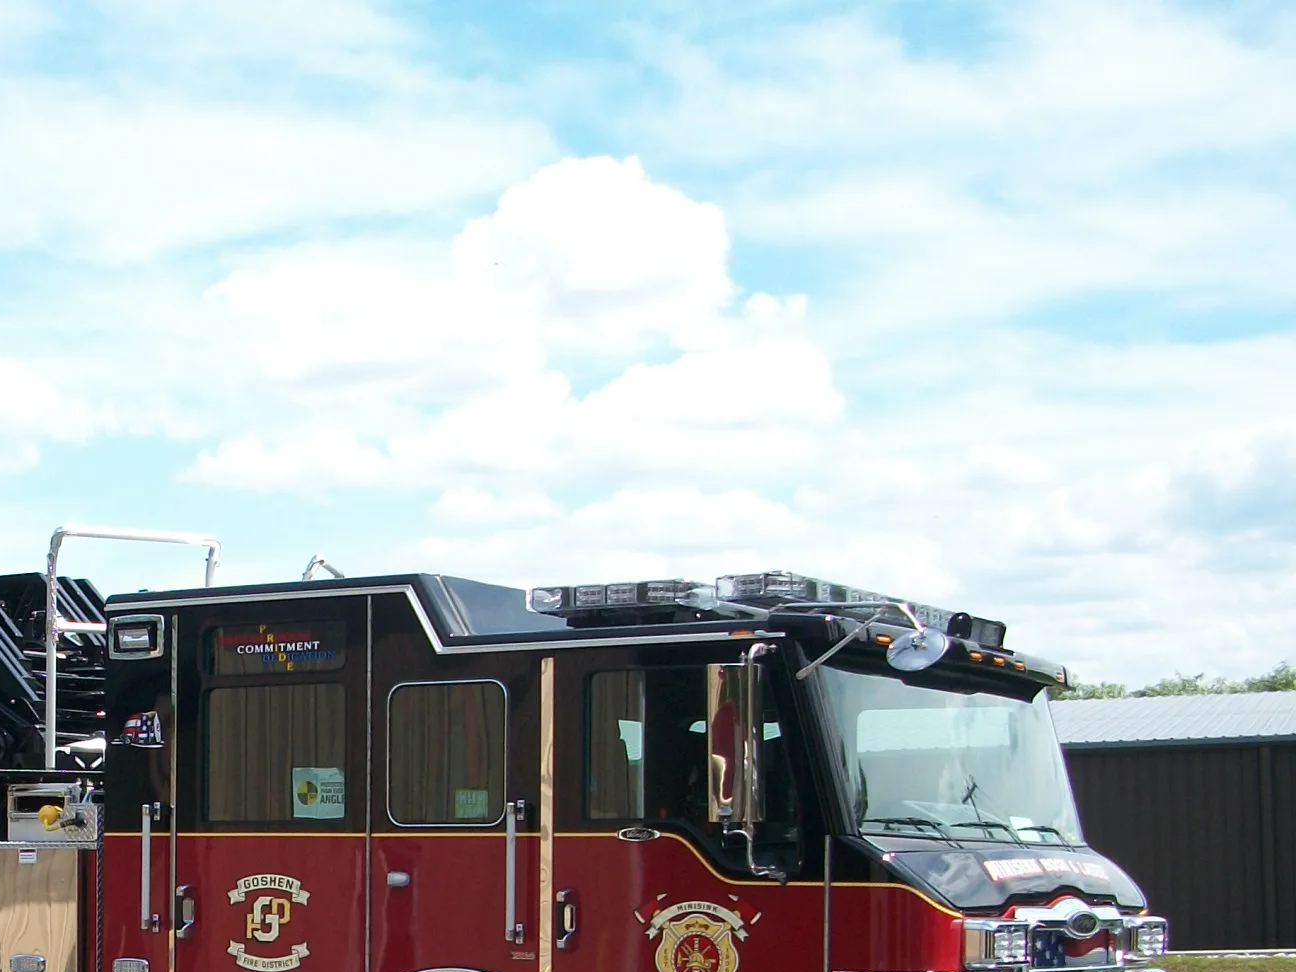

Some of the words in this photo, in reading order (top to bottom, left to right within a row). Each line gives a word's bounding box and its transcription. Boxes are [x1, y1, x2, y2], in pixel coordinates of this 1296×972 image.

[236, 640, 321, 654] COMMITMENT
[243, 876, 294, 890] GOSHEN
[677, 902, 719, 913] MINISINK
[242, 957, 258, 968] FIRE
[262, 958, 294, 969] DISTRICT
